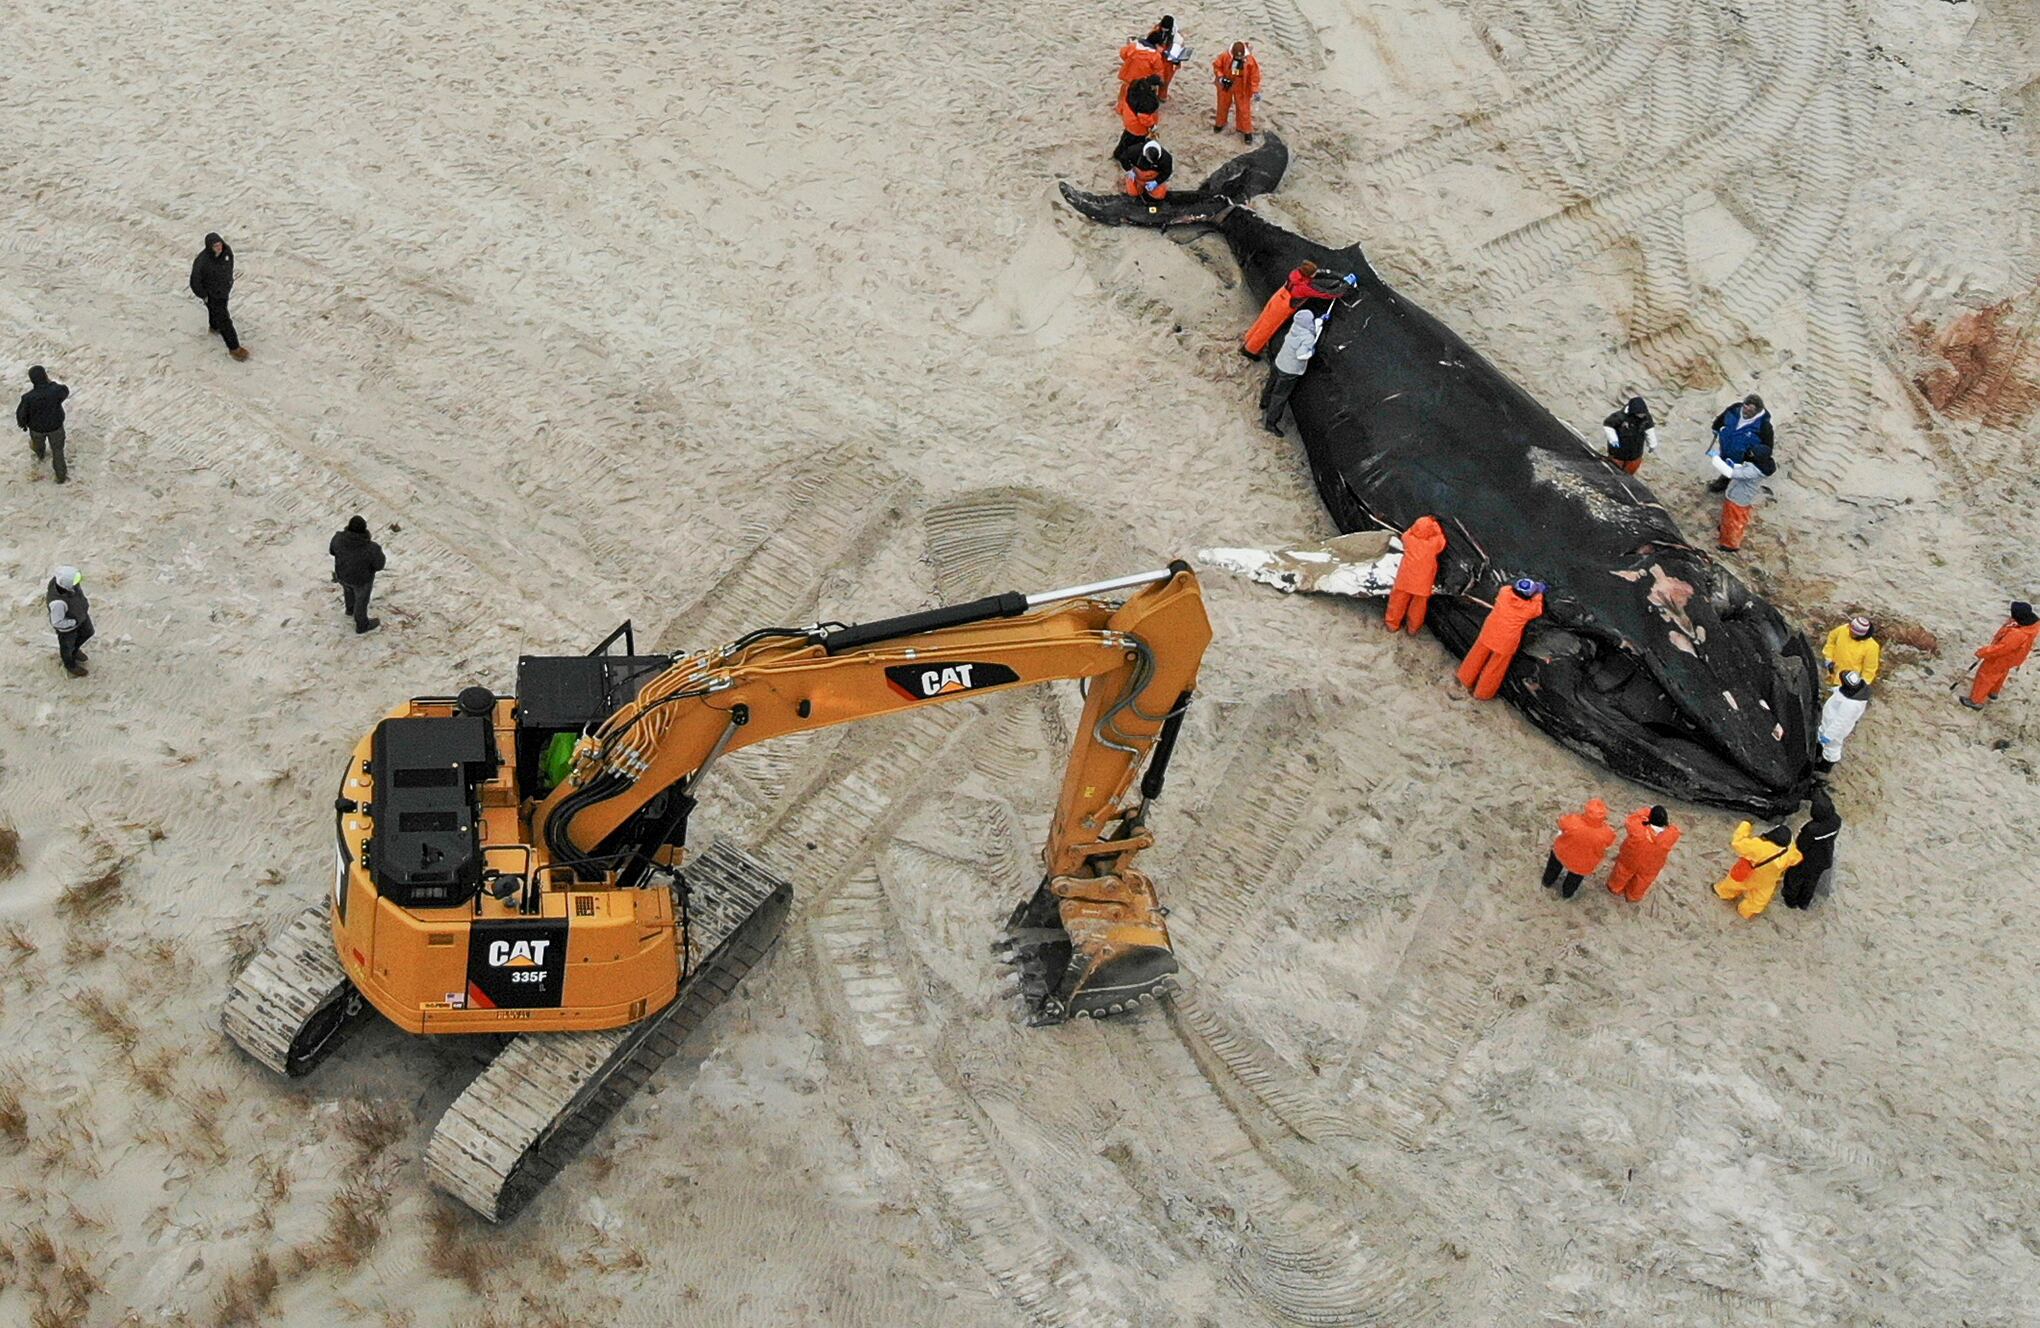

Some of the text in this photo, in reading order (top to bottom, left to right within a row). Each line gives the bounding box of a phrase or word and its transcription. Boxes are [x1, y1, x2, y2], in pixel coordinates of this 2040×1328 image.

[921, 664, 973, 696] CAT
[489, 940, 550, 967] CAT
[512, 971, 547, 983] 335F
